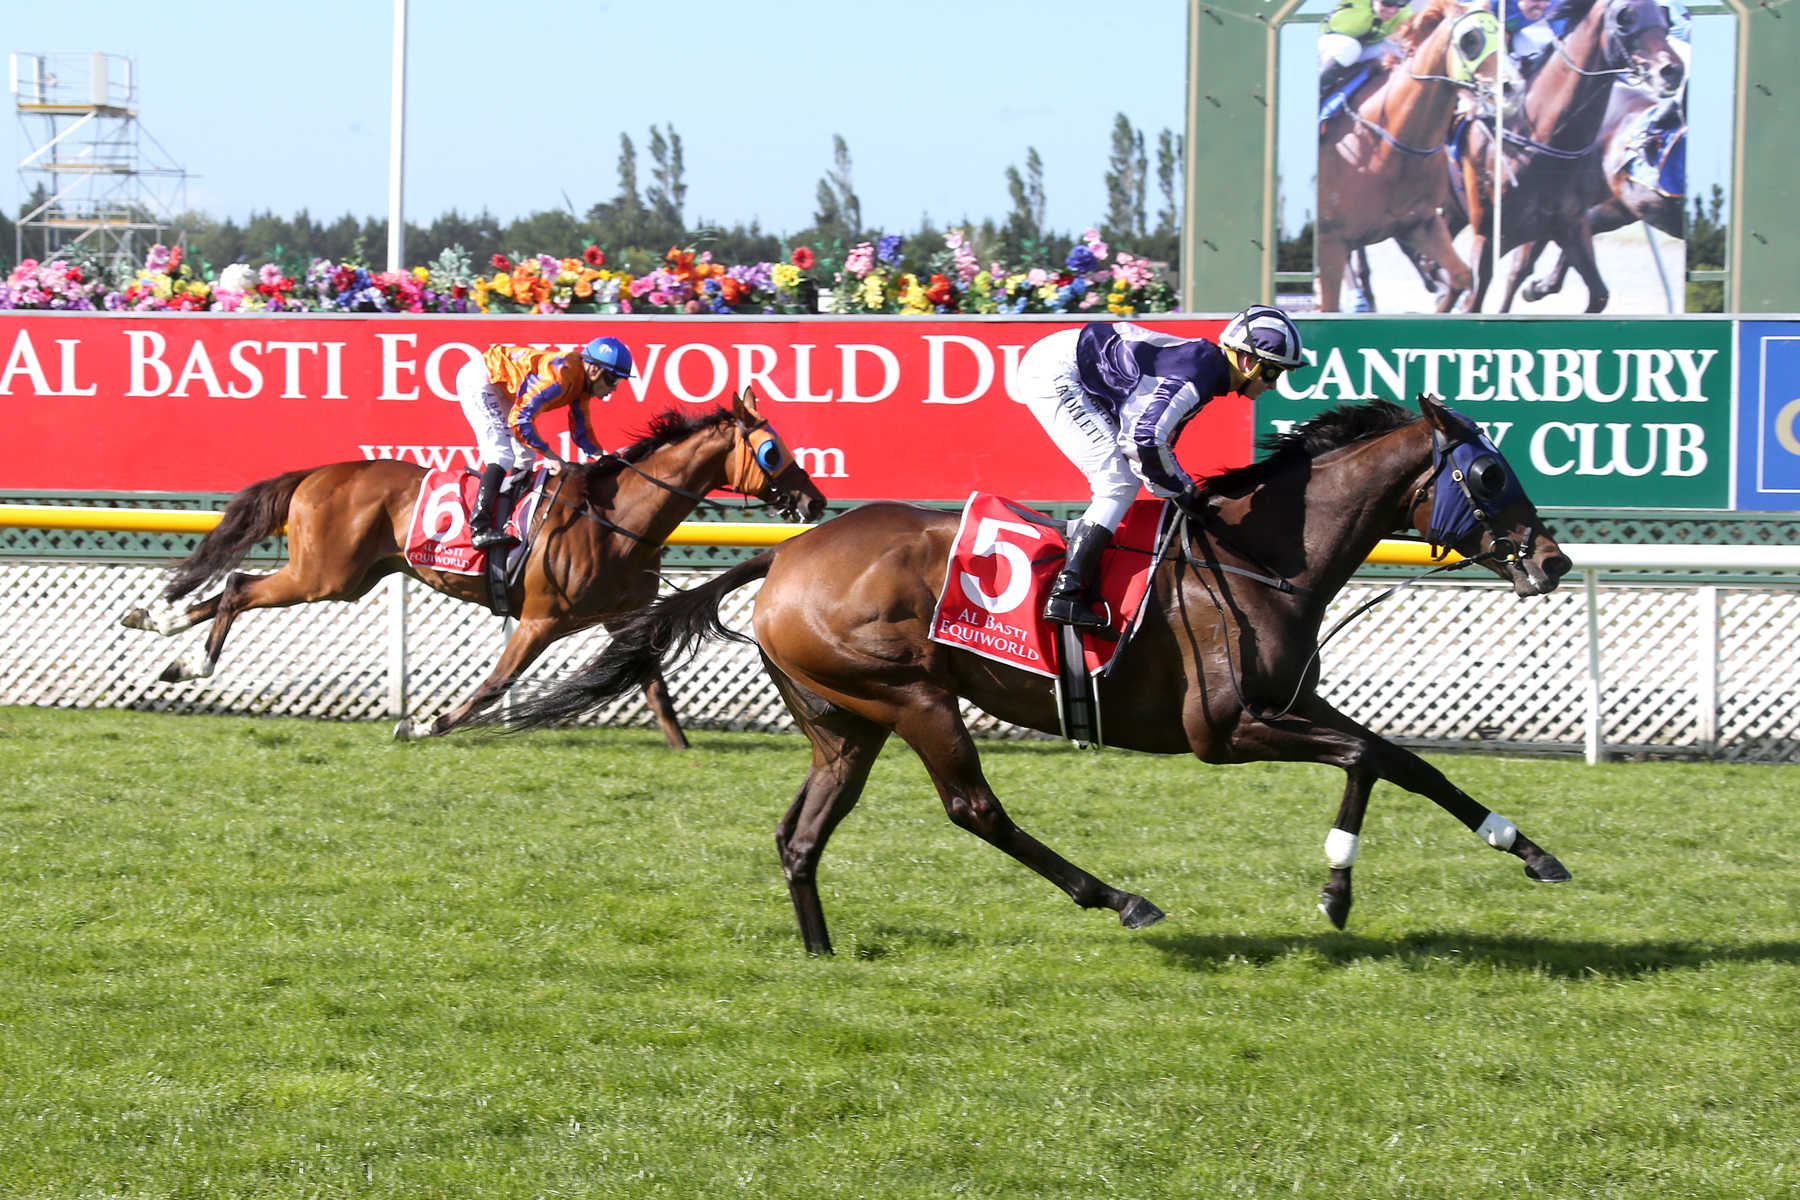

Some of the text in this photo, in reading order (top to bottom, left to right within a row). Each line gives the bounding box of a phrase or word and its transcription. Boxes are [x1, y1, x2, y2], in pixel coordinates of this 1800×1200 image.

[0, 328, 97, 397] AL
[123, 330, 348, 400] BASTI
[376, 333, 900, 404] EQWORLD
[1275, 347, 1719, 402] CANTERBURY
[1529, 421, 1709, 477] CLUB
[422, 482, 466, 543] 6
[409, 551, 470, 568] EQUIWORLD
[421, 543, 432, 552] AL
[960, 516, 1042, 614] 5
[939, 619, 1039, 661] EQUIWORLD
[957, 608, 1028, 642] AL BASTI
